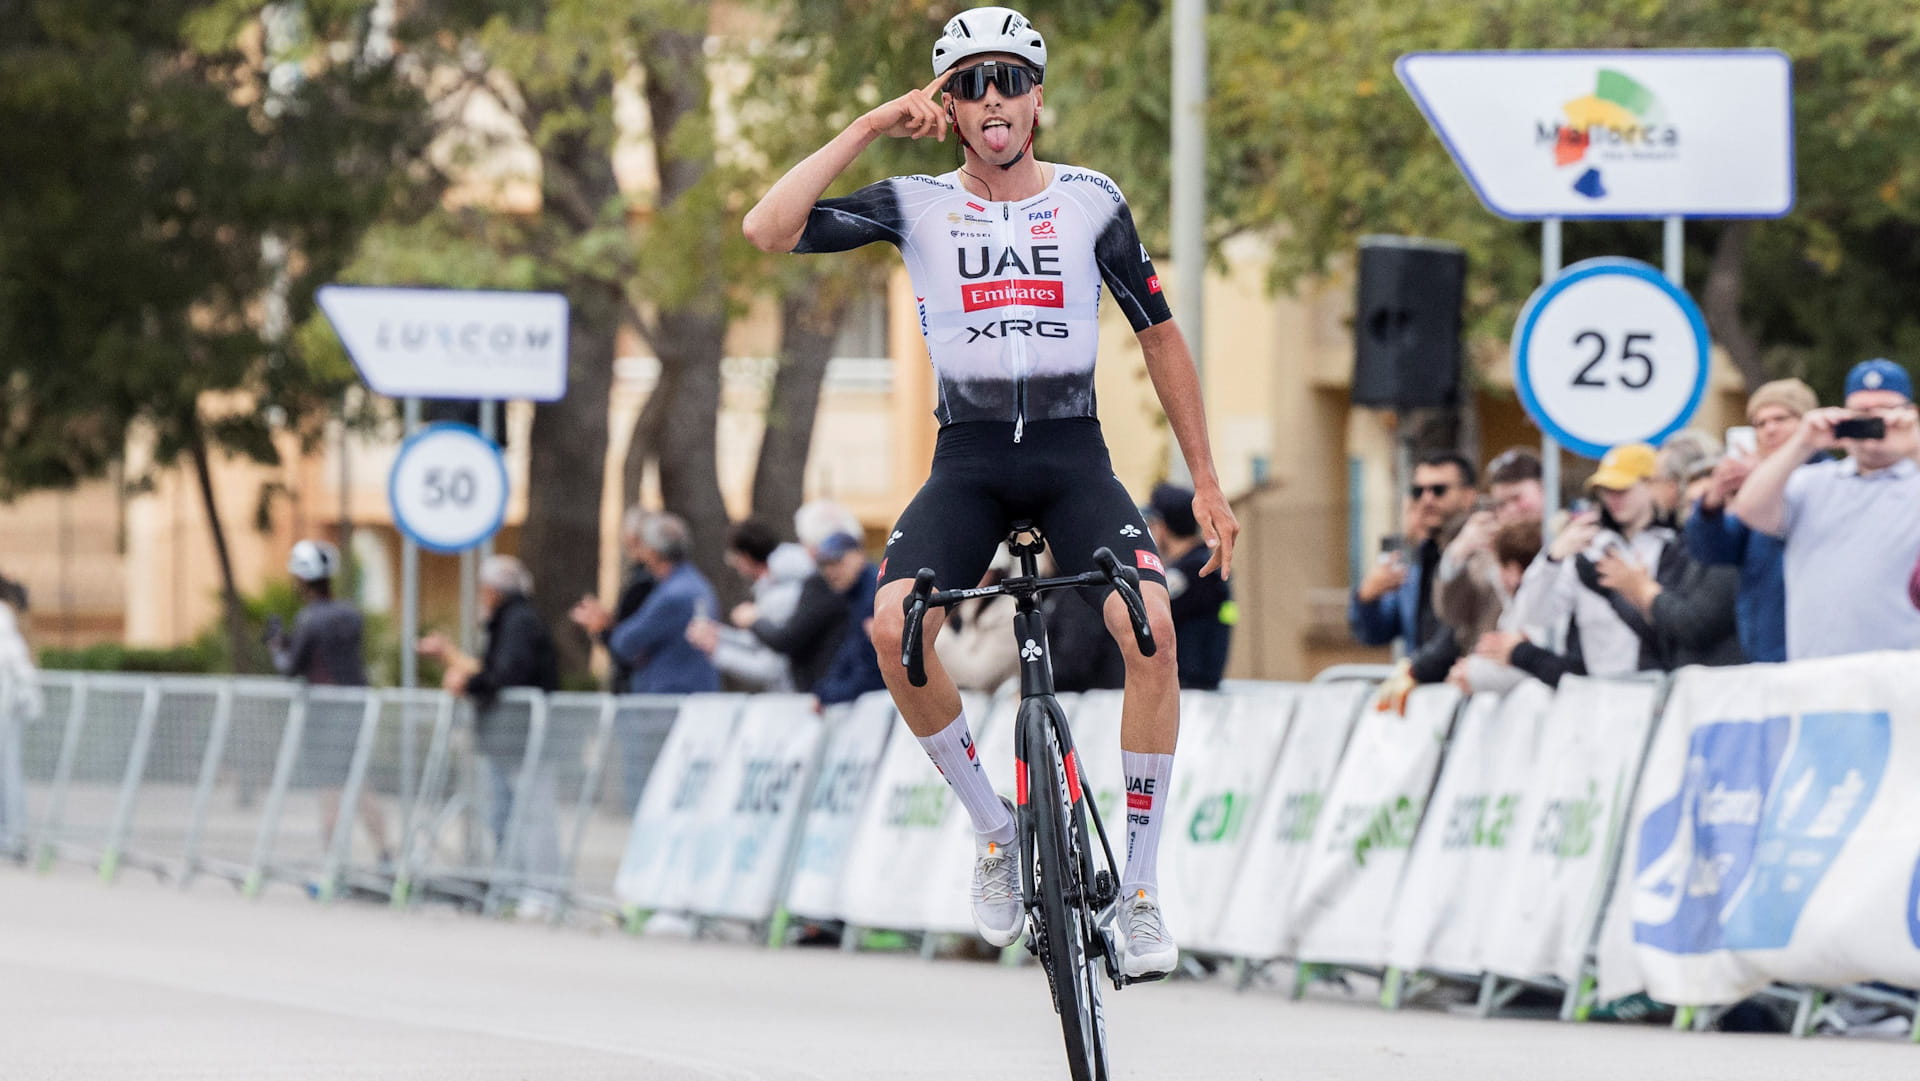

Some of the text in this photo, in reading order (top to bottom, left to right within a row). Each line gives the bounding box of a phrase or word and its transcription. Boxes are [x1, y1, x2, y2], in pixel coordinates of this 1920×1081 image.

[1073, 172, 1121, 203] Analog
[1028, 210, 1053, 221] FAB
[957, 244, 1062, 279] UAE
[971, 285, 1056, 304] Emirates
[965, 319, 1069, 344] XRG
[1571, 330, 1656, 389] 25
[421, 466, 477, 508] 50
